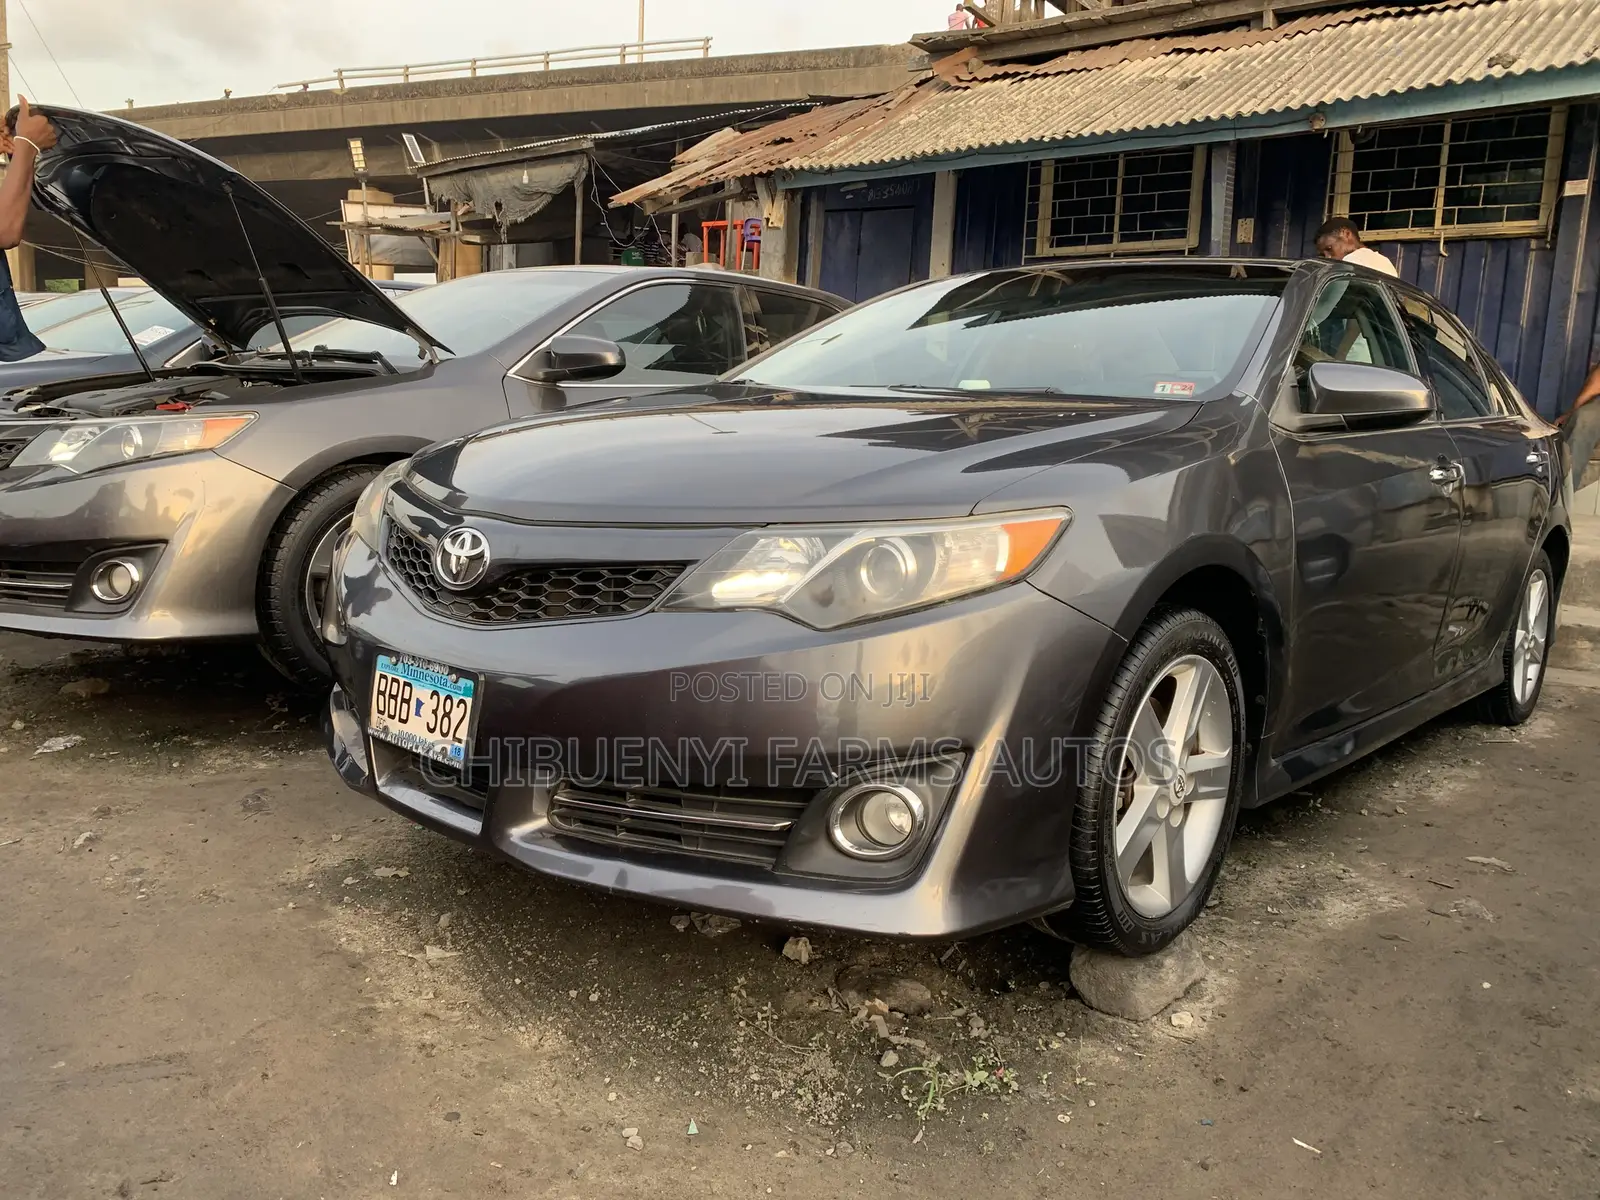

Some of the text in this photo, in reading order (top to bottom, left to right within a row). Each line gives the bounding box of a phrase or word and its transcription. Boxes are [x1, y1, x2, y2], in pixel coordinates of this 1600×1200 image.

[401, 664, 462, 692] Minnesota.com
[377, 673, 468, 744] BBB 382
[453, 747, 461, 757] 18
